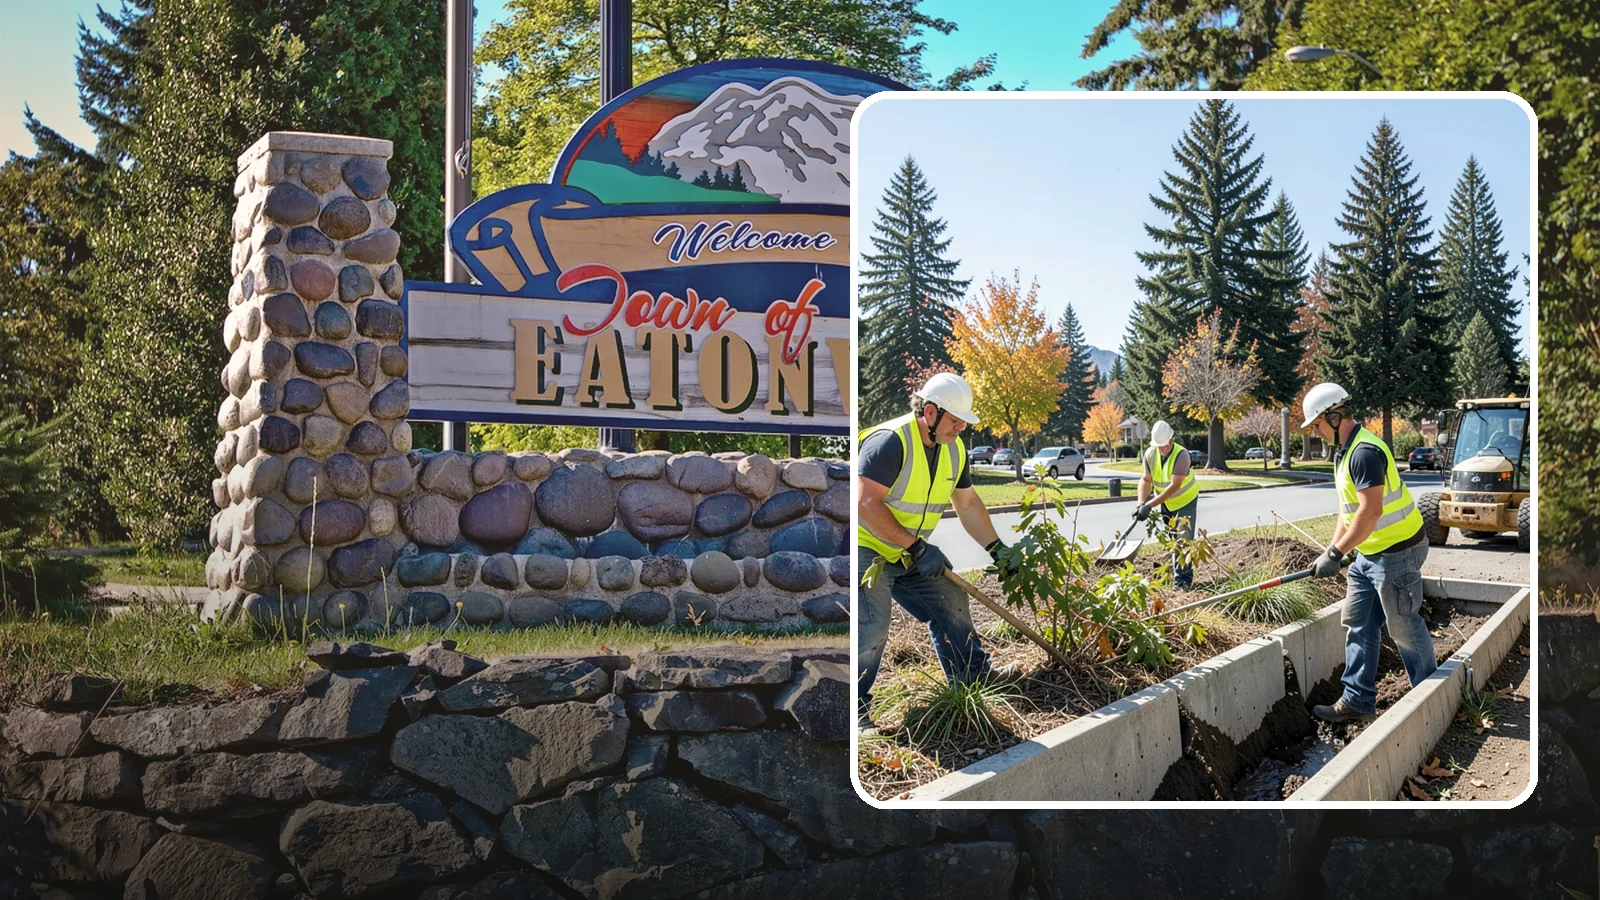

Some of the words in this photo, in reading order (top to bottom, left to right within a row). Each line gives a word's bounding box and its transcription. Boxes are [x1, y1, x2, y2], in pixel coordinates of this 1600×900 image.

[653, 221, 837, 263] Welcome
[557, 263, 736, 336] Town
[765, 279, 825, 365] of
